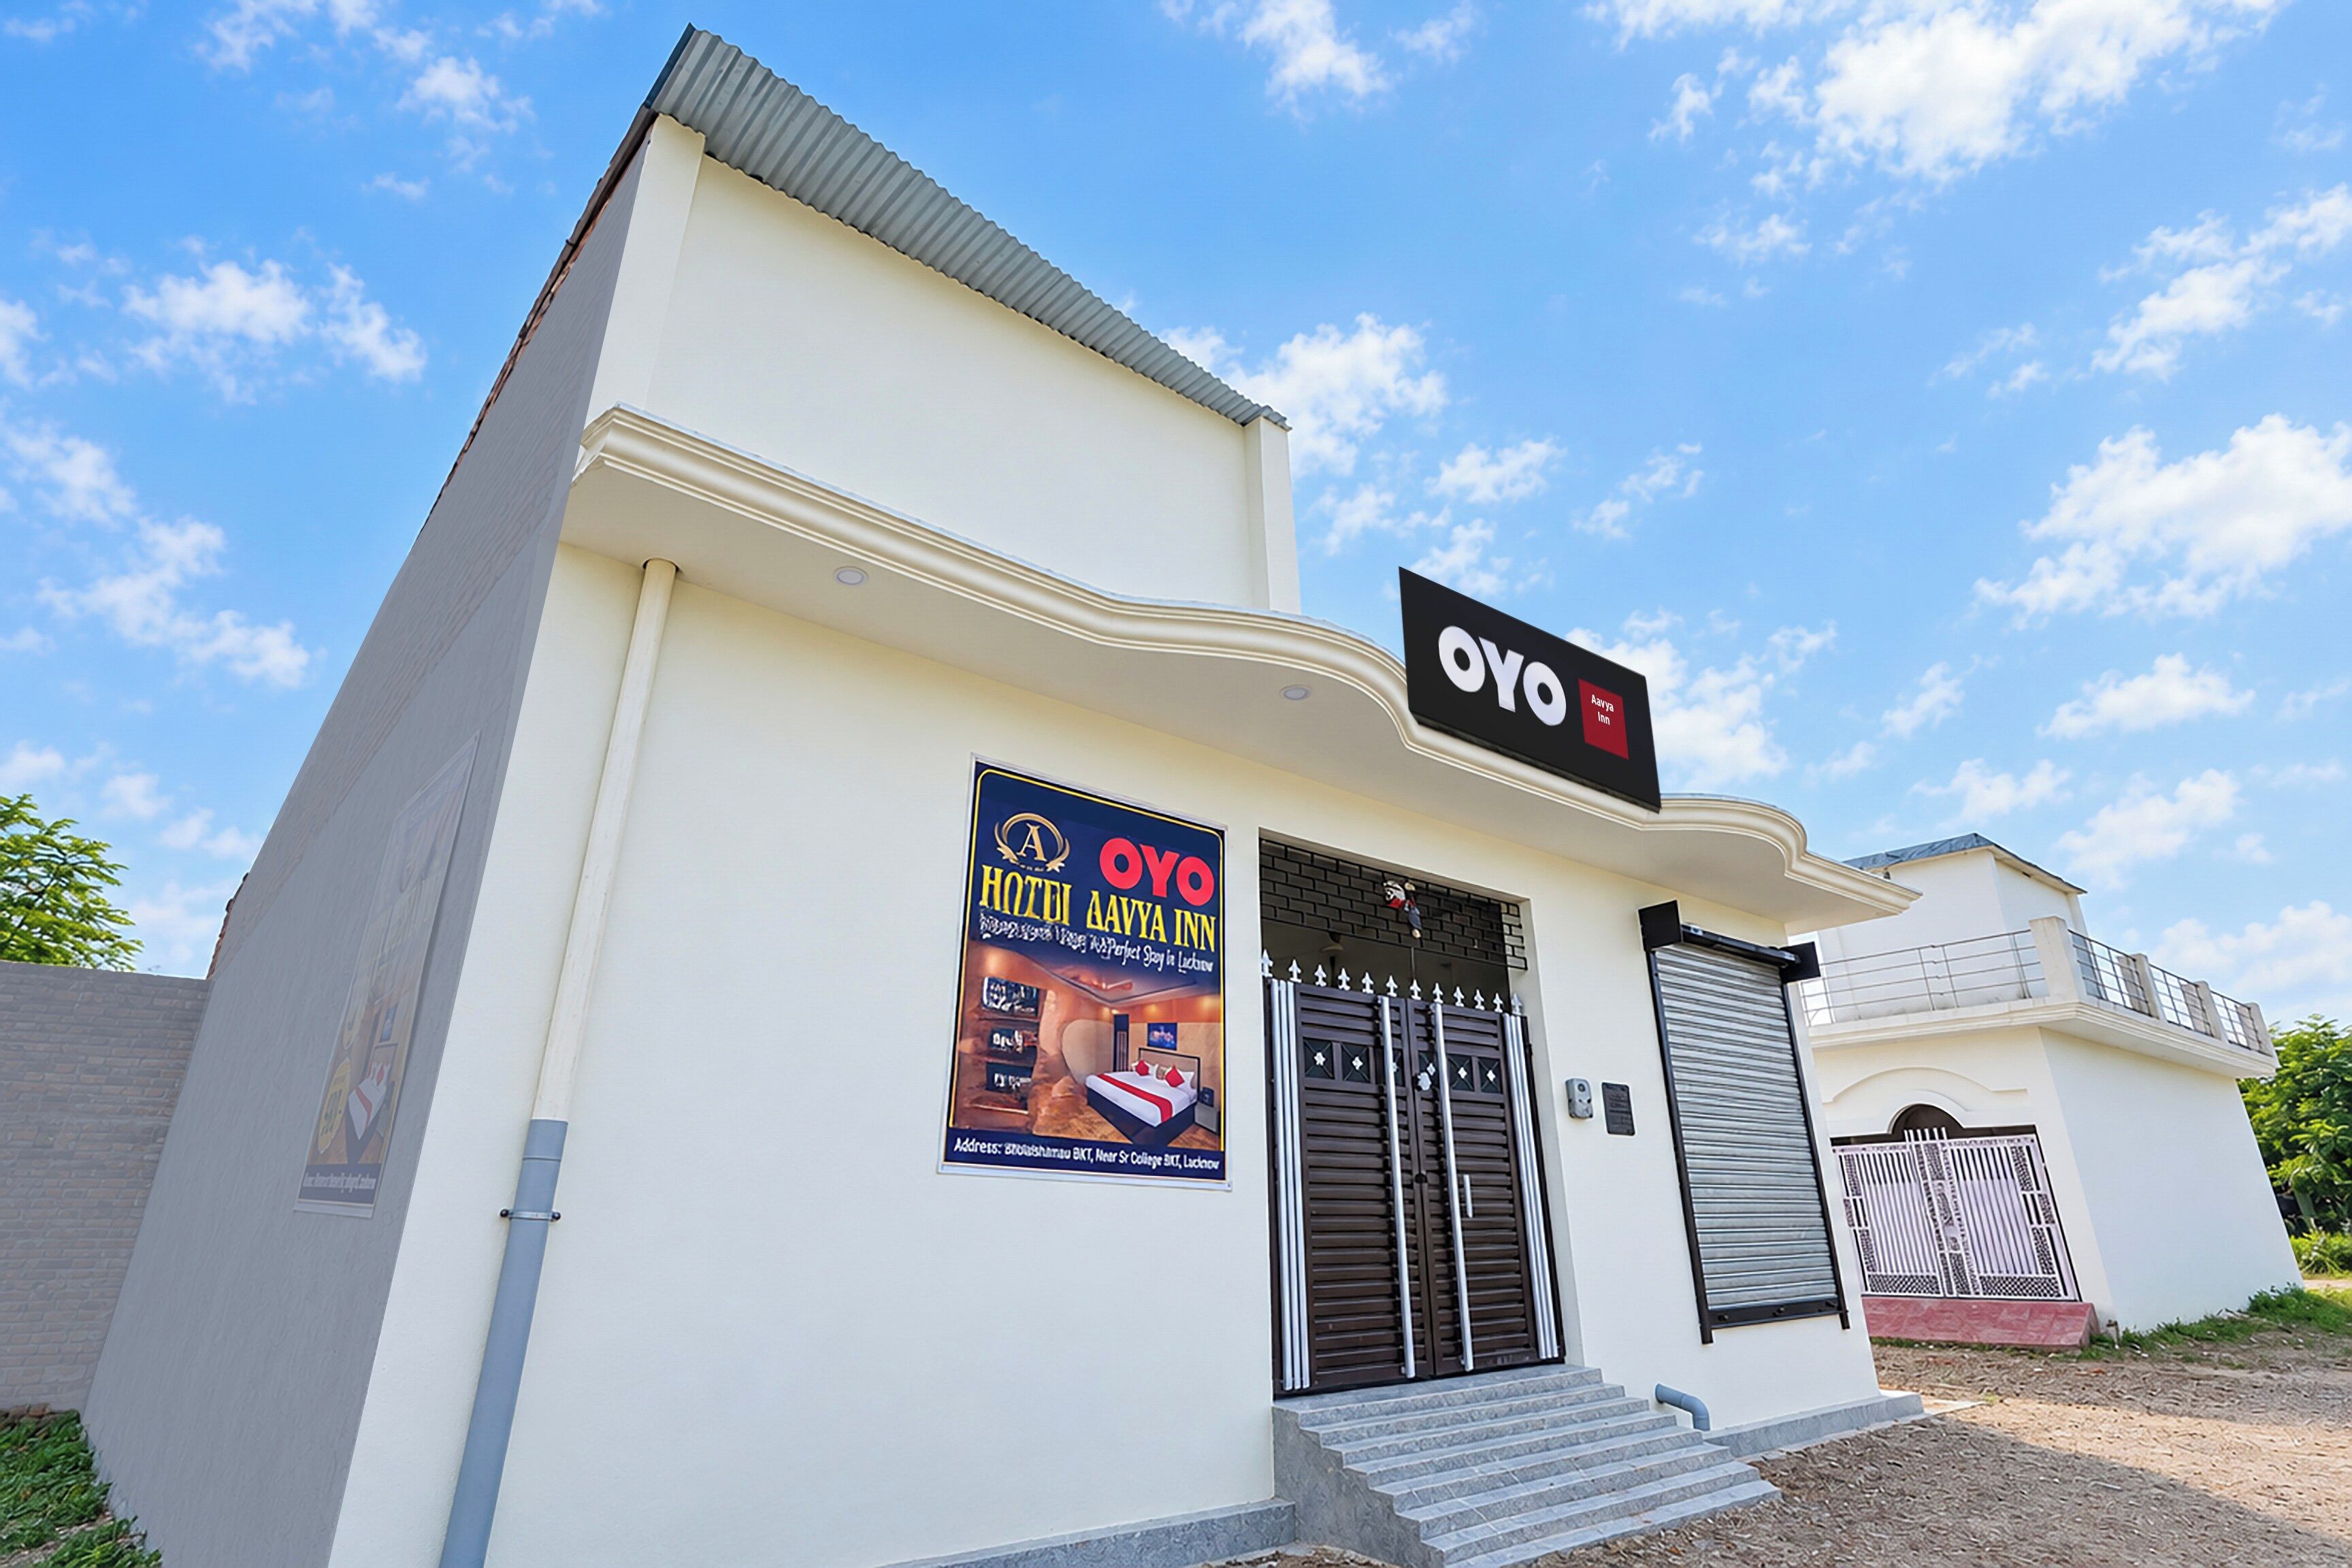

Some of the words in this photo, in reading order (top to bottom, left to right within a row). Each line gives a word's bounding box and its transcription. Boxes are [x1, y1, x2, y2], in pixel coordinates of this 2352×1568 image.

[1438, 625, 1567, 727] OYO
[1591, 693, 1614, 713] Aavya
[1597, 710, 1610, 726] Inn
[1016, 822, 1047, 862] A
[1099, 837, 1215, 906] OYO
[1086, 889, 1168, 943] AAVYA
[1173, 908, 1217, 953] INN
